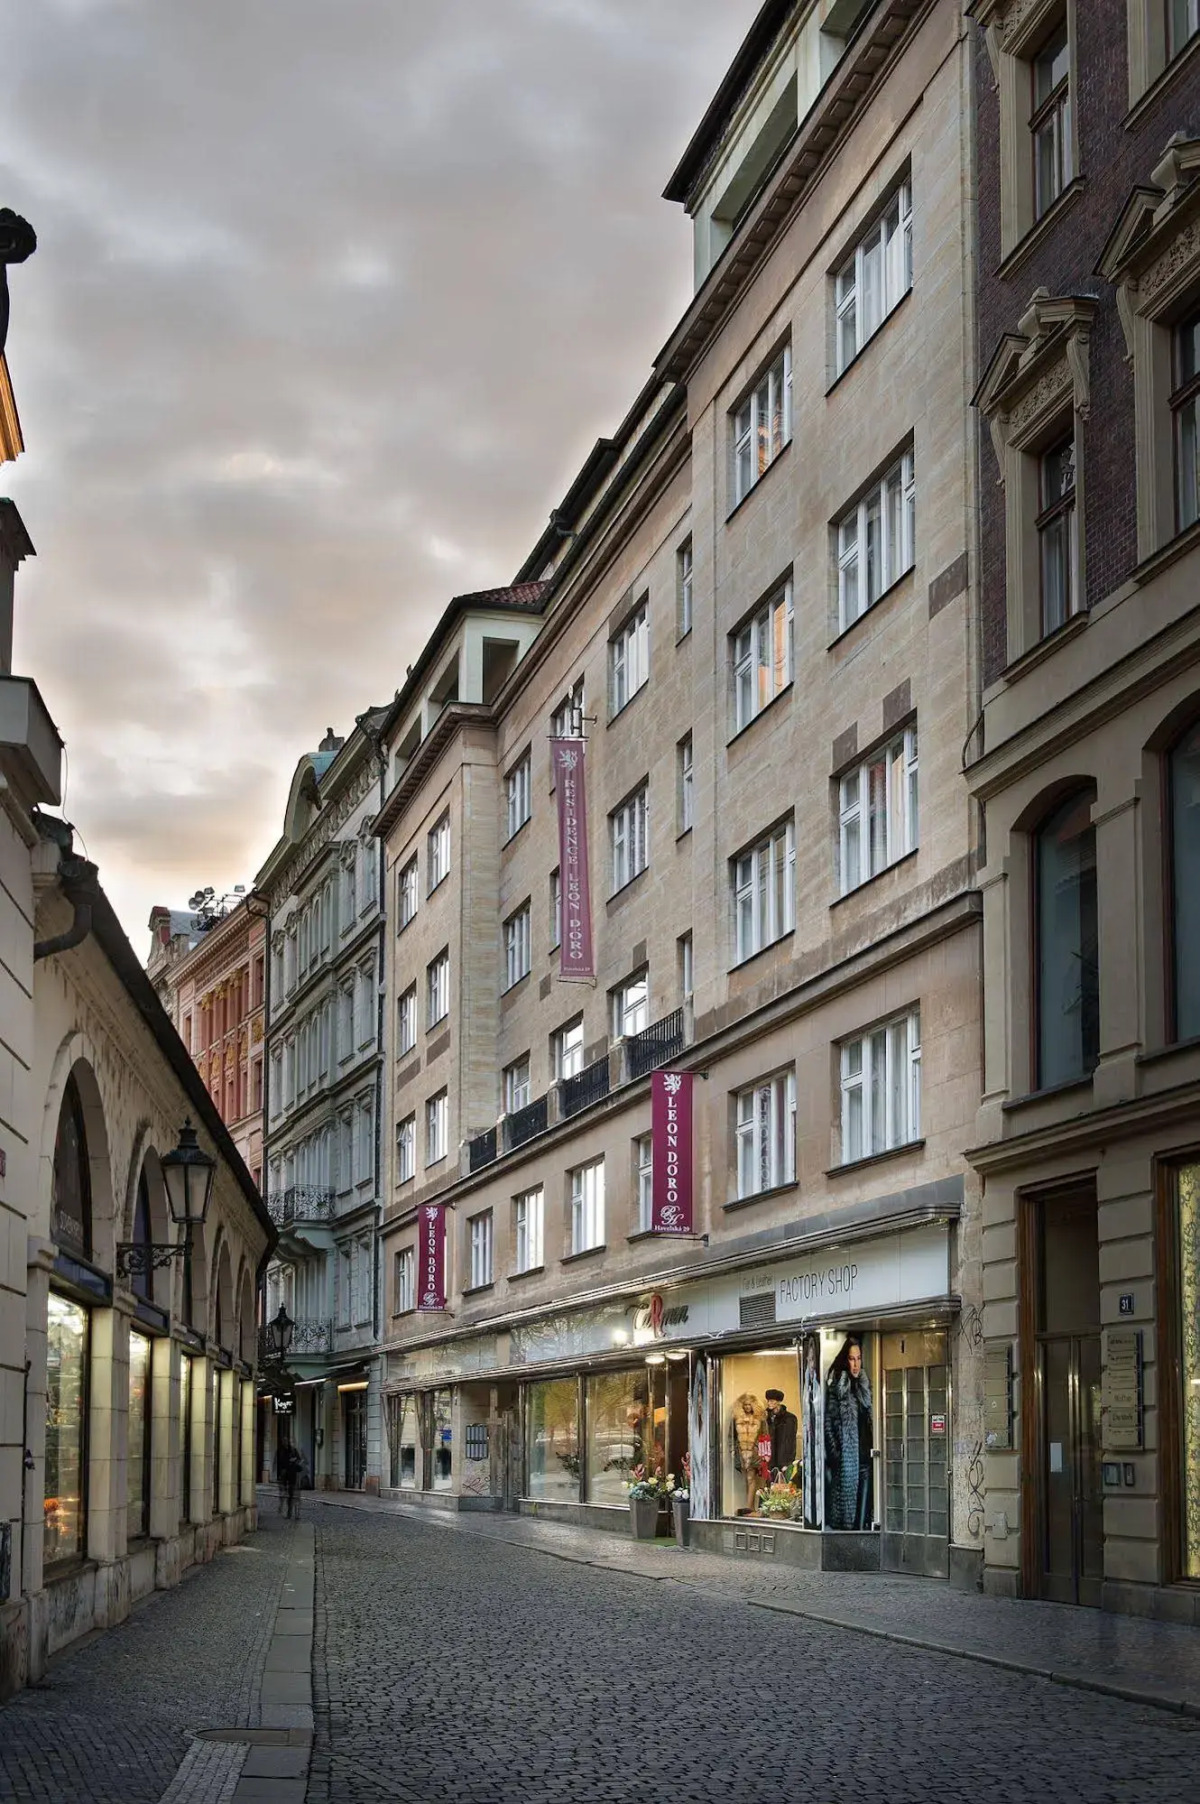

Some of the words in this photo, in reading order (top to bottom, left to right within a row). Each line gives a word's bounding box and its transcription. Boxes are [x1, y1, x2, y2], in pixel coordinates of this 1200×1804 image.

[569, 873, 580, 910] LEON
[666, 1096, 679, 1148] LEON
[428, 1222, 436, 1255] LEON
[780, 1270, 826, 1304] FACTORY
[827, 1264, 858, 1295] SHOP
[1121, 1299, 1130, 1310] 31
